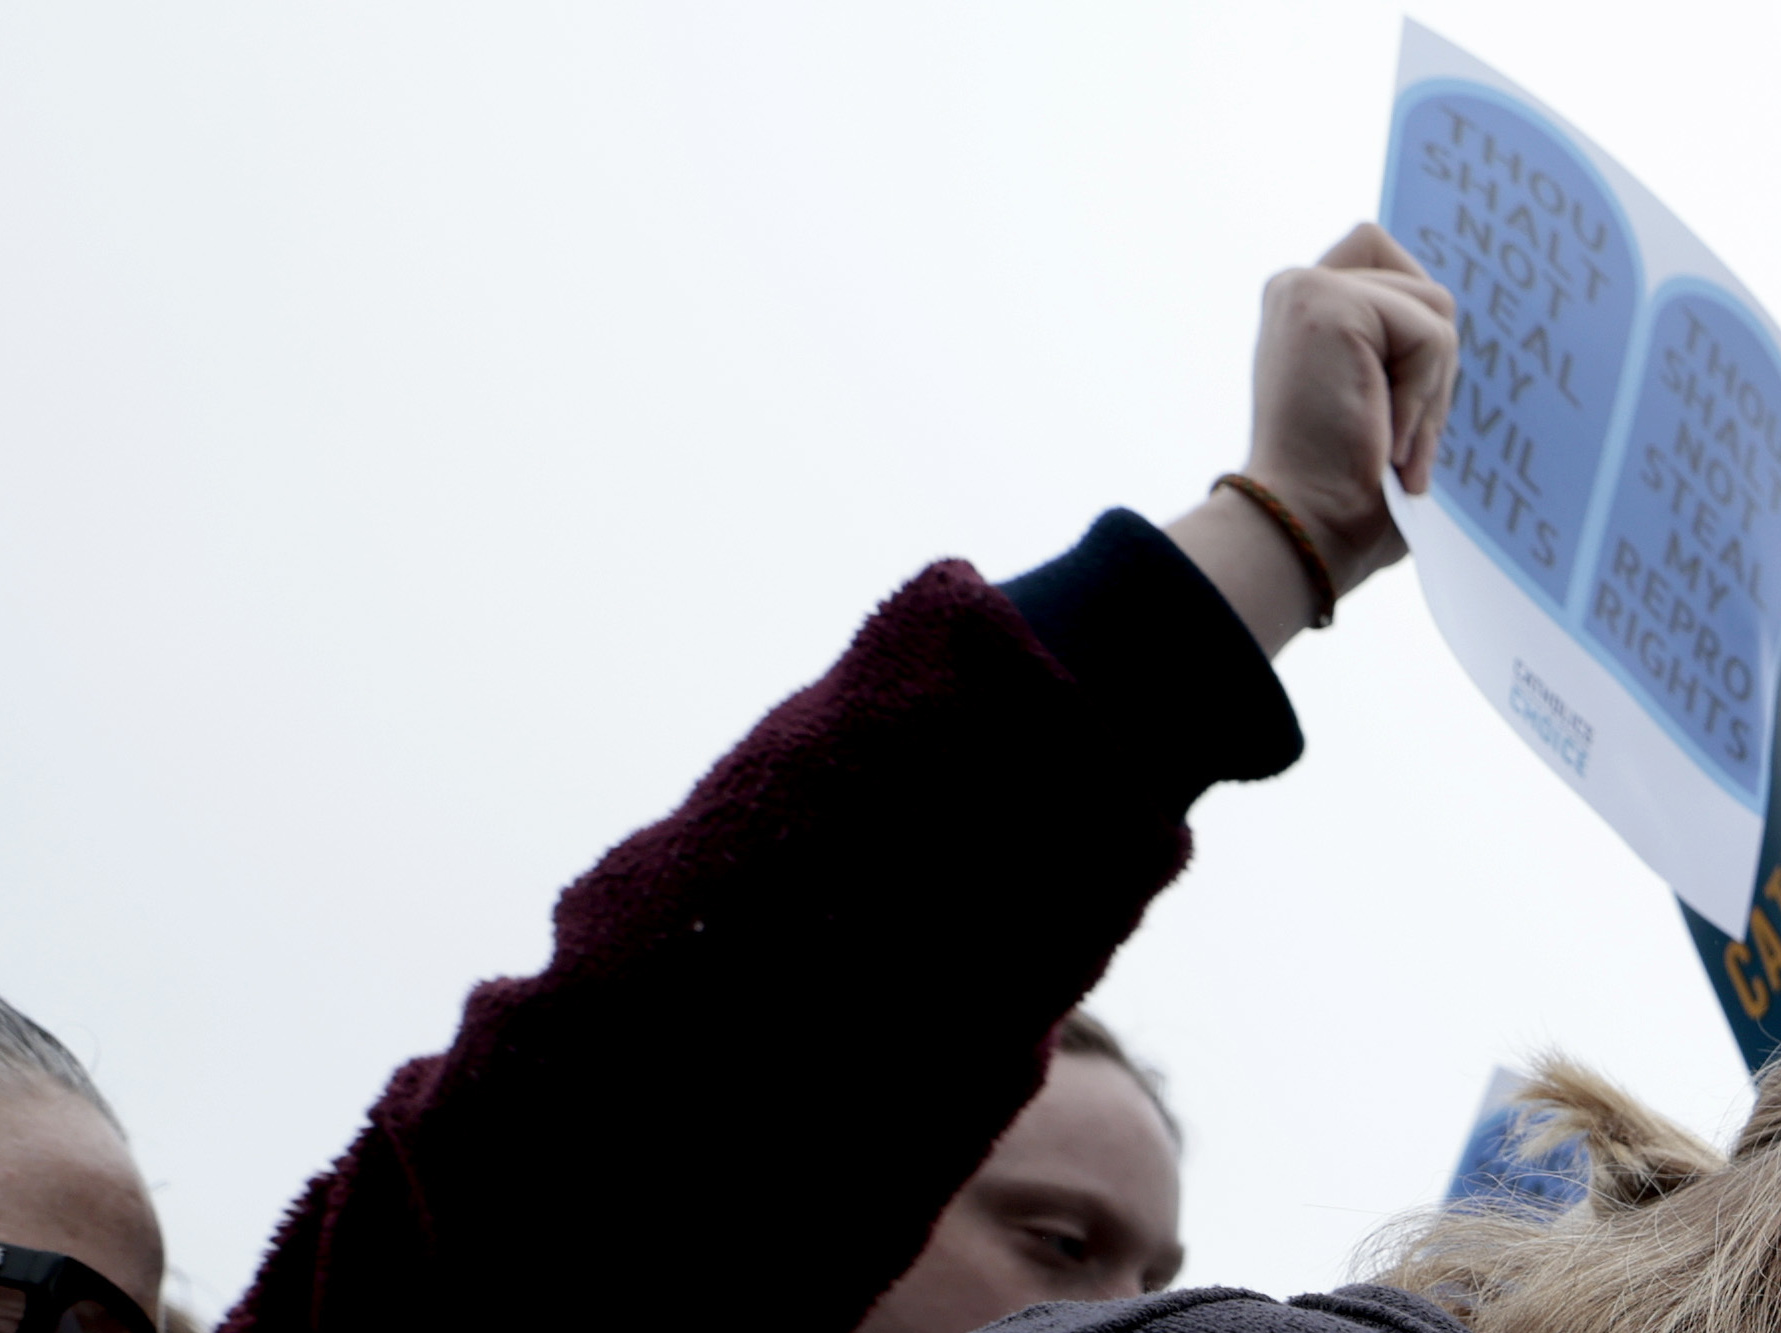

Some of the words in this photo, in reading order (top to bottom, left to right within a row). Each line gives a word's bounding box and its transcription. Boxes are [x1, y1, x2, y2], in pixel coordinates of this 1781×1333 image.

[1420, 141, 1611, 303] SHALT
[1435, 104, 1610, 256] THOU
[1415, 226, 1584, 410] STEAL
[1452, 200, 1573, 323] NOT
[1451, 365, 1541, 496] IVIL
[1458, 308, 1535, 405] MY
[1436, 420, 1560, 570] GHTS
[1638, 445, 1768, 615] STEAL
[1674, 419, 1765, 535] NOT
[1611, 535, 1755, 704] REPRO
[1662, 516, 1733, 611] MY
[1593, 583, 1751, 765] RIGHTS
